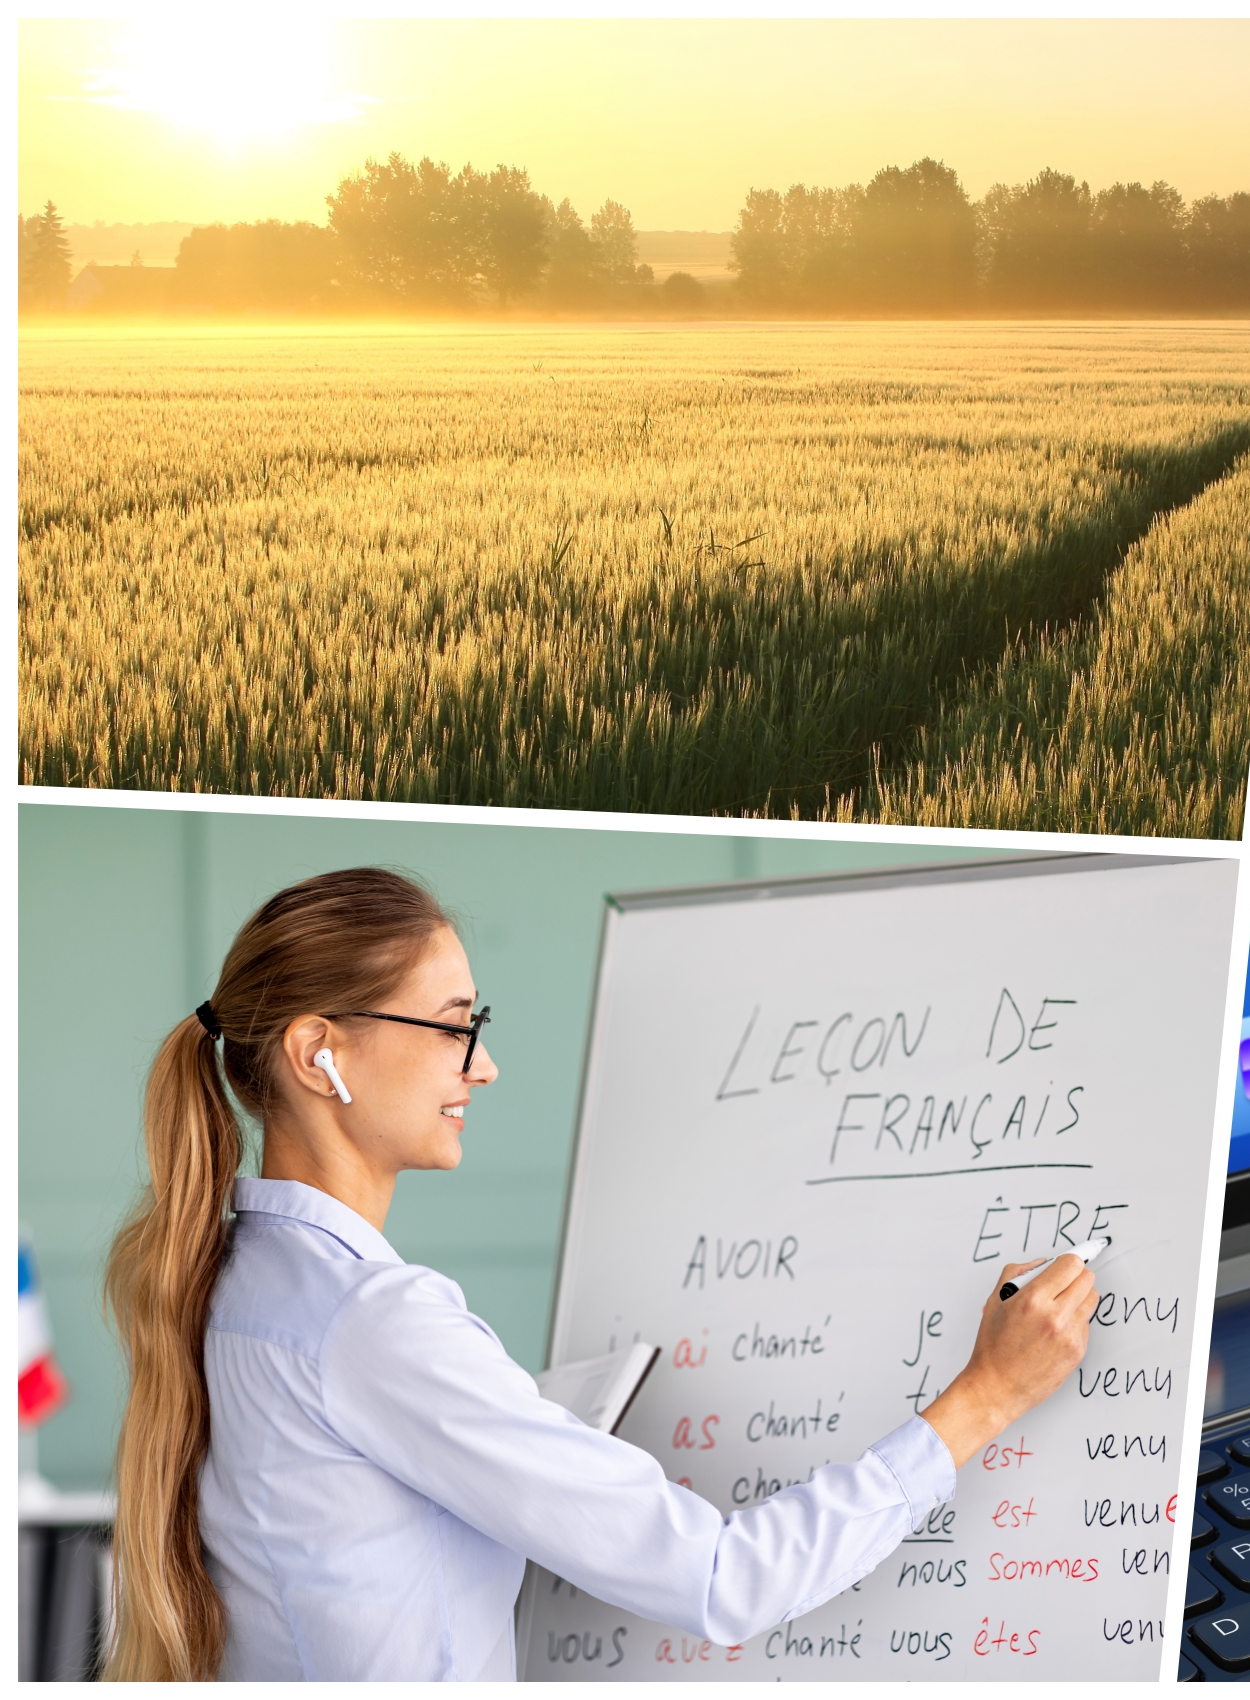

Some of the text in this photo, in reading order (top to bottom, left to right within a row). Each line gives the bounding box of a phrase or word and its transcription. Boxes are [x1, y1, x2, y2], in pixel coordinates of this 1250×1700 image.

[715, 986, 1078, 1101] LEÇON DE
[830, 1080, 1085, 1166] FRANÇAIS
[682, 1234, 799, 1291] AVOIR
[672, 1328, 710, 1369] ai
[731, 1313, 832, 1362] chanté
[902, 1292, 1180, 1367] je enu
[905, 1365, 940, 1415] t
[671, 1391, 845, 1451] as chanté
[982, 1435, 1035, 1471] est
[991, 1497, 1038, 1529] est
[1222, 1483, 1249, 1497] %
[897, 1557, 968, 1589] nous
[547, 1625, 628, 1669] vous
[765, 1618, 864, 1660] chanté
[890, 1628, 953, 1662] vous
[973, 1616, 1042, 1657] êtes
[1211, 1618, 1240, 1636] D
